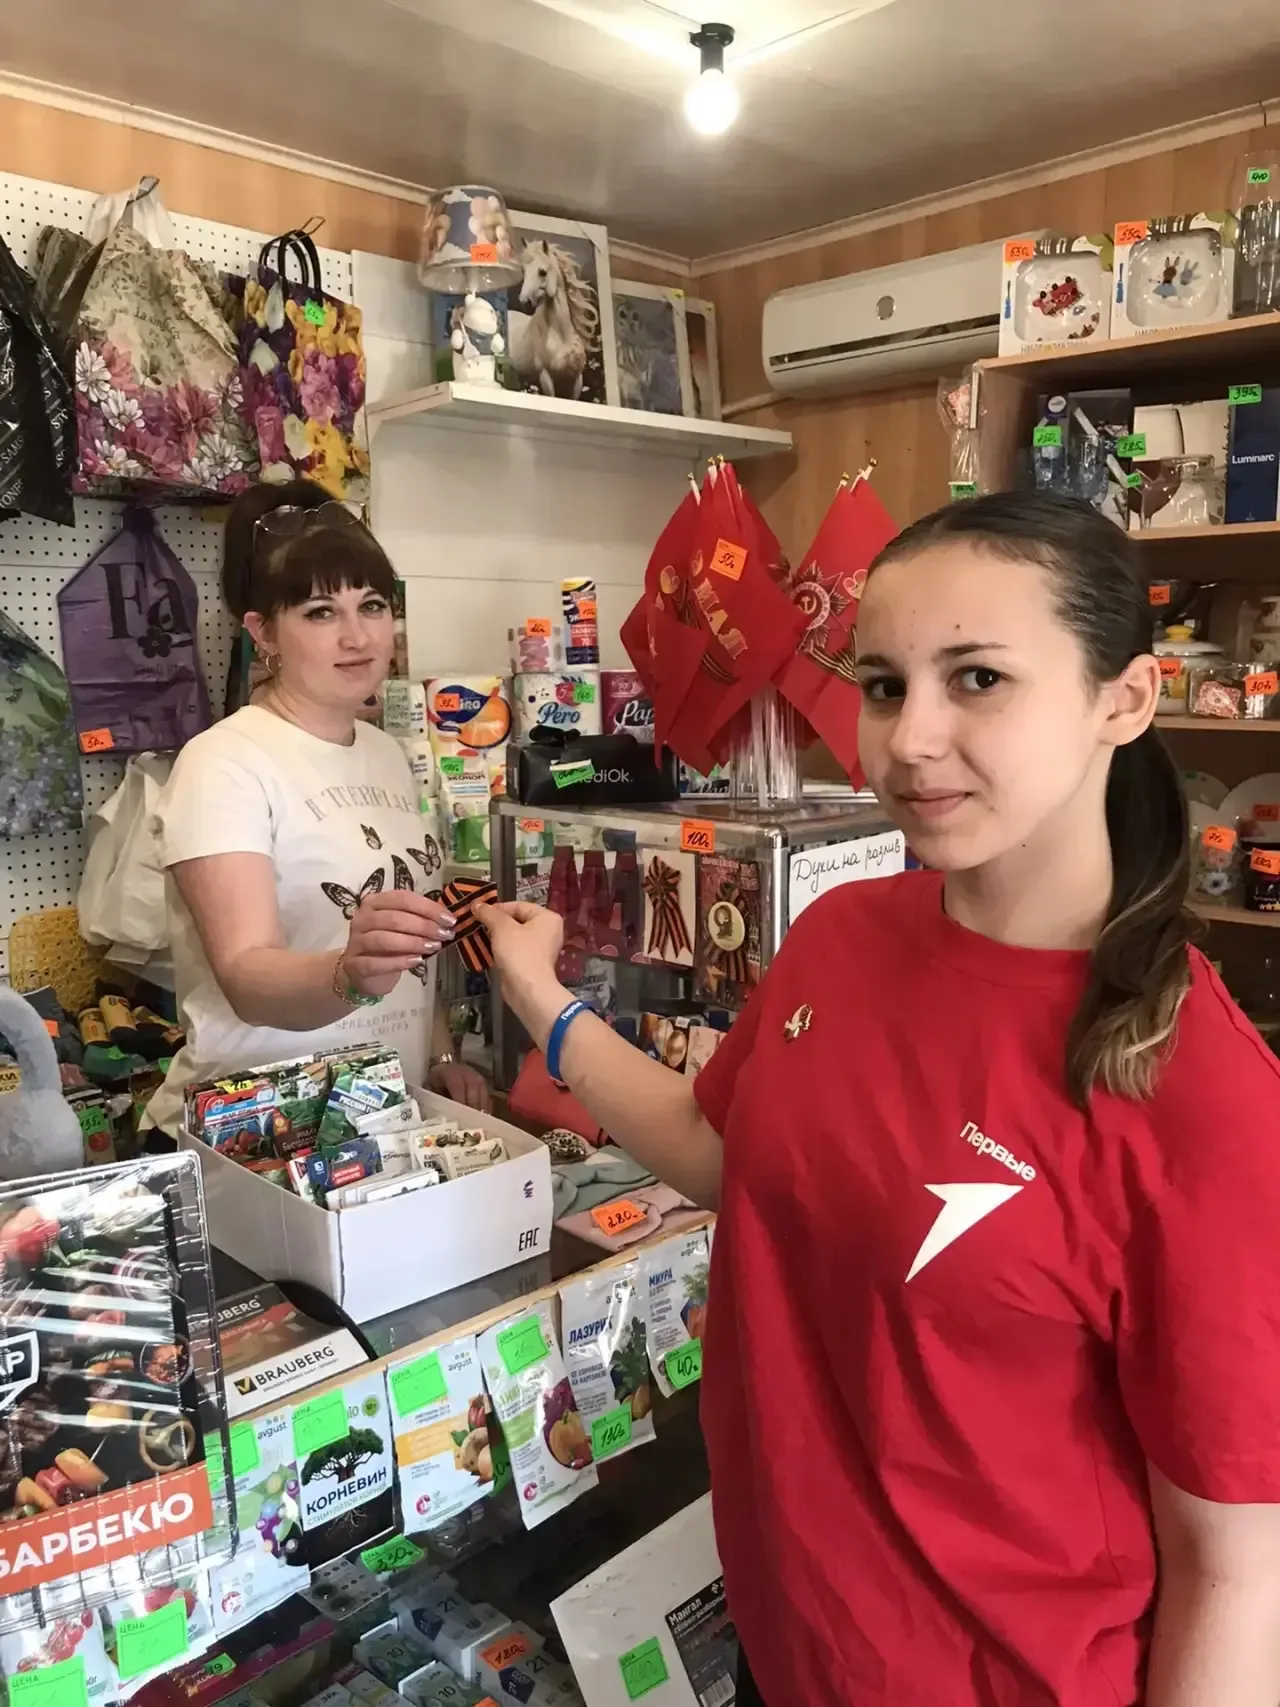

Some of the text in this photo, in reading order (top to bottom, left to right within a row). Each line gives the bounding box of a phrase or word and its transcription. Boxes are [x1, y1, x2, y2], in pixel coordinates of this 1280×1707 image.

[1231, 453, 1275, 465] Luminarc
[792, 838, 901, 893] Духи на разлив
[960, 1121, 1036, 1181] Первые
[518, 1227, 540, 1251] EAC
[649, 1268, 673, 1287] МИУРА
[255, 1345, 335, 1386] BRAUBERG
[448, 1357, 473, 1372] avgust
[257, 1421, 288, 1441] avgust
[306, 1466, 388, 1516] КОРНЕВИН
[668, 1598, 702, 1626] Мангал
[526, 1654, 552, 1674] 21
[438, 1686, 457, 1699] 10
